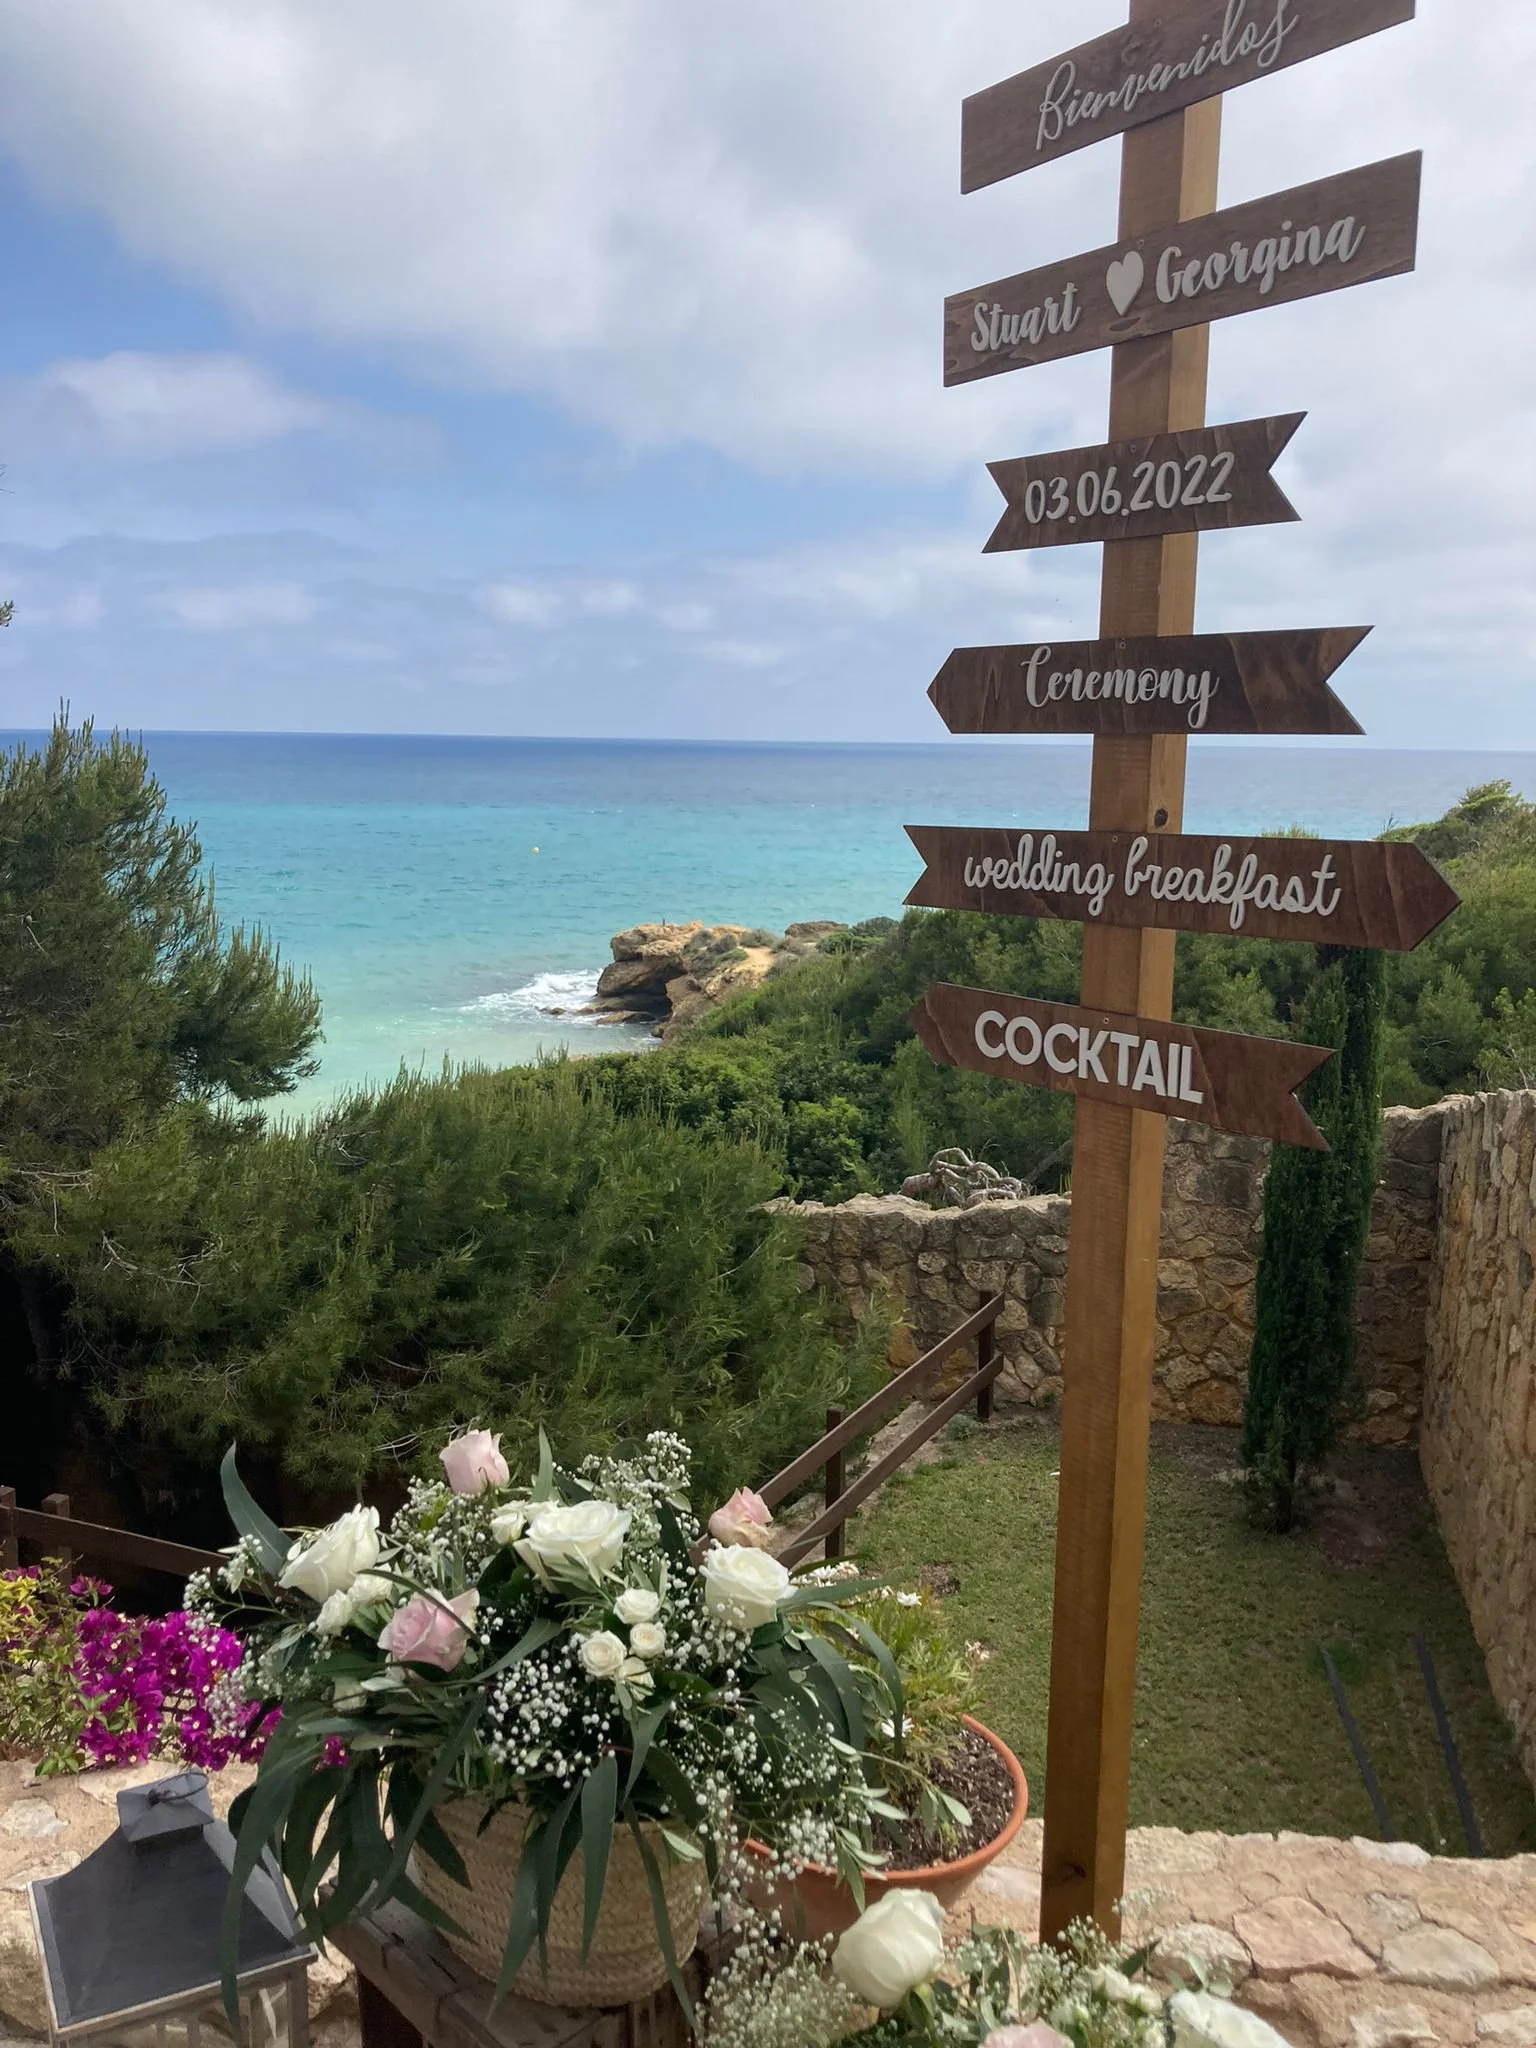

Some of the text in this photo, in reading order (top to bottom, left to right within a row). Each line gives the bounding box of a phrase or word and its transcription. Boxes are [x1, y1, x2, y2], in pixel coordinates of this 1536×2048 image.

[1035, 0, 1299, 151] Bienvenidos
[971, 216, 1366, 352] Stuart Georgina
[1024, 451, 1235, 525] 03.06.2022
[1020, 645, 1220, 729] Ceremony
[964, 833, 1342, 931] wedding breakfast
[974, 1009, 1204, 1105] COCKTAIL
